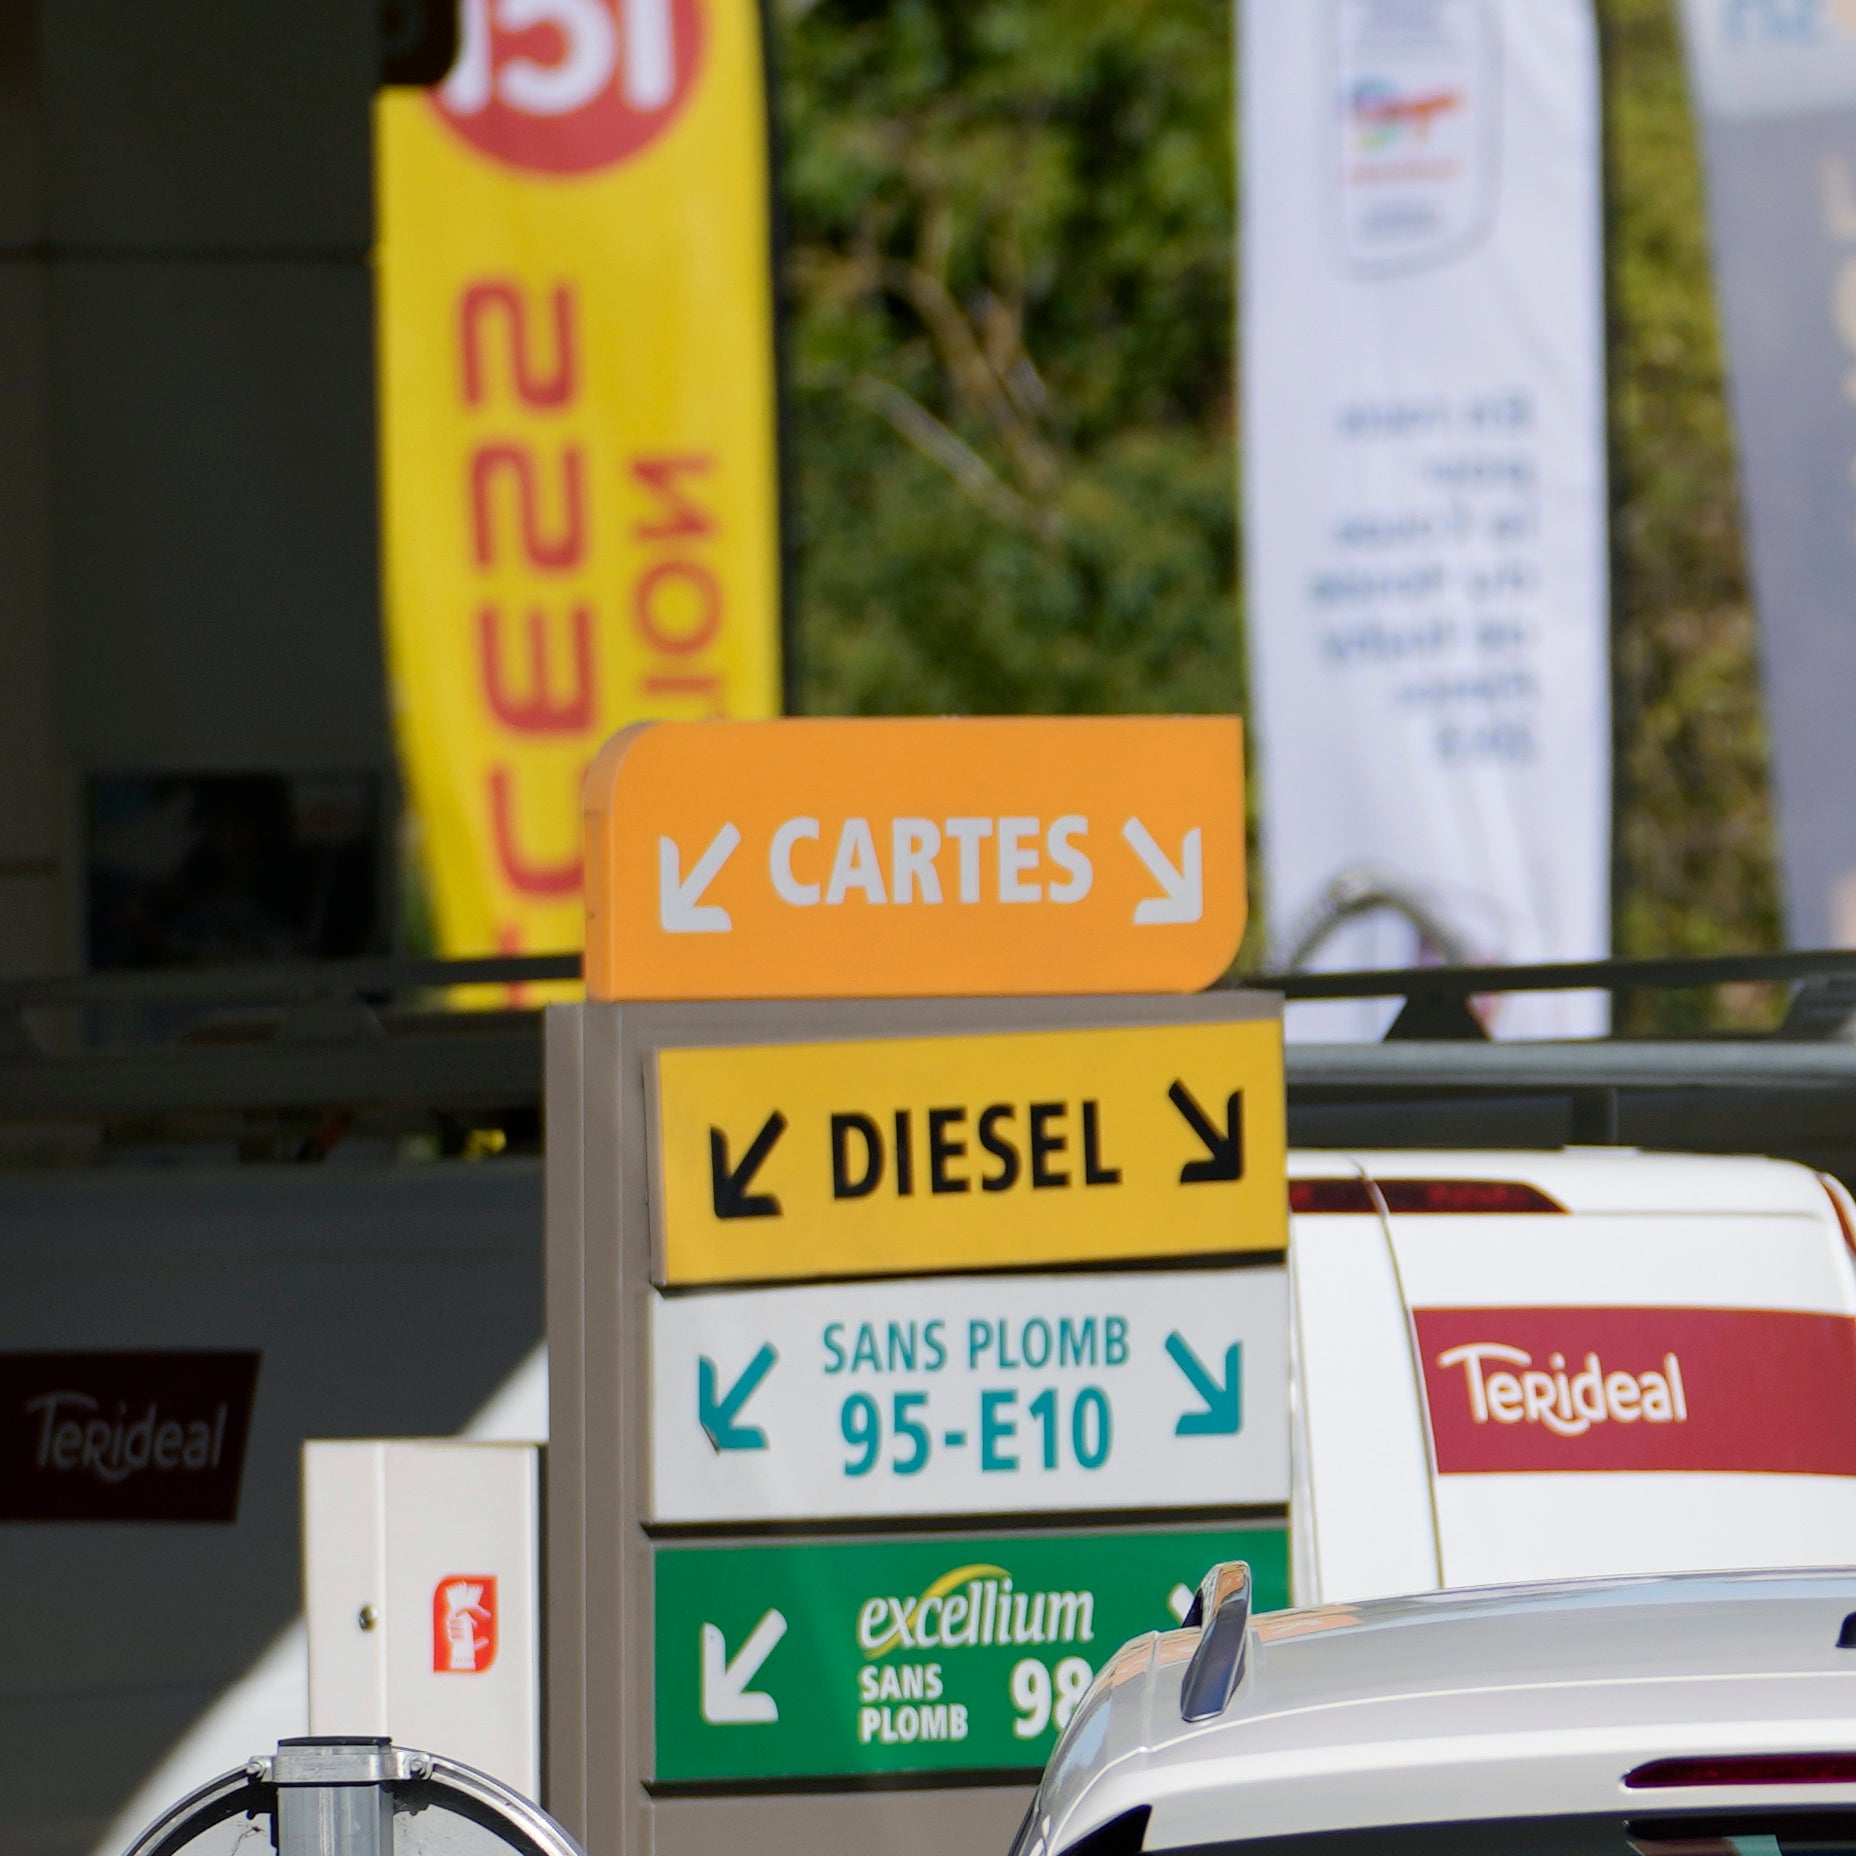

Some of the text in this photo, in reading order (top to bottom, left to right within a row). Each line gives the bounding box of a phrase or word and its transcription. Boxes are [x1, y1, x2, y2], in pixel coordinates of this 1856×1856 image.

[768, 815, 1094, 908] CARTES
[828, 1099, 1122, 1201] DIESEL
[823, 1315, 1131, 1375] SANS PLOMB
[840, 1385, 1114, 1477] 95-E10
[857, 1566, 1096, 1652] excellium
[859, 1663, 944, 1704] SANS
[859, 1702, 969, 1744] PLOMB
